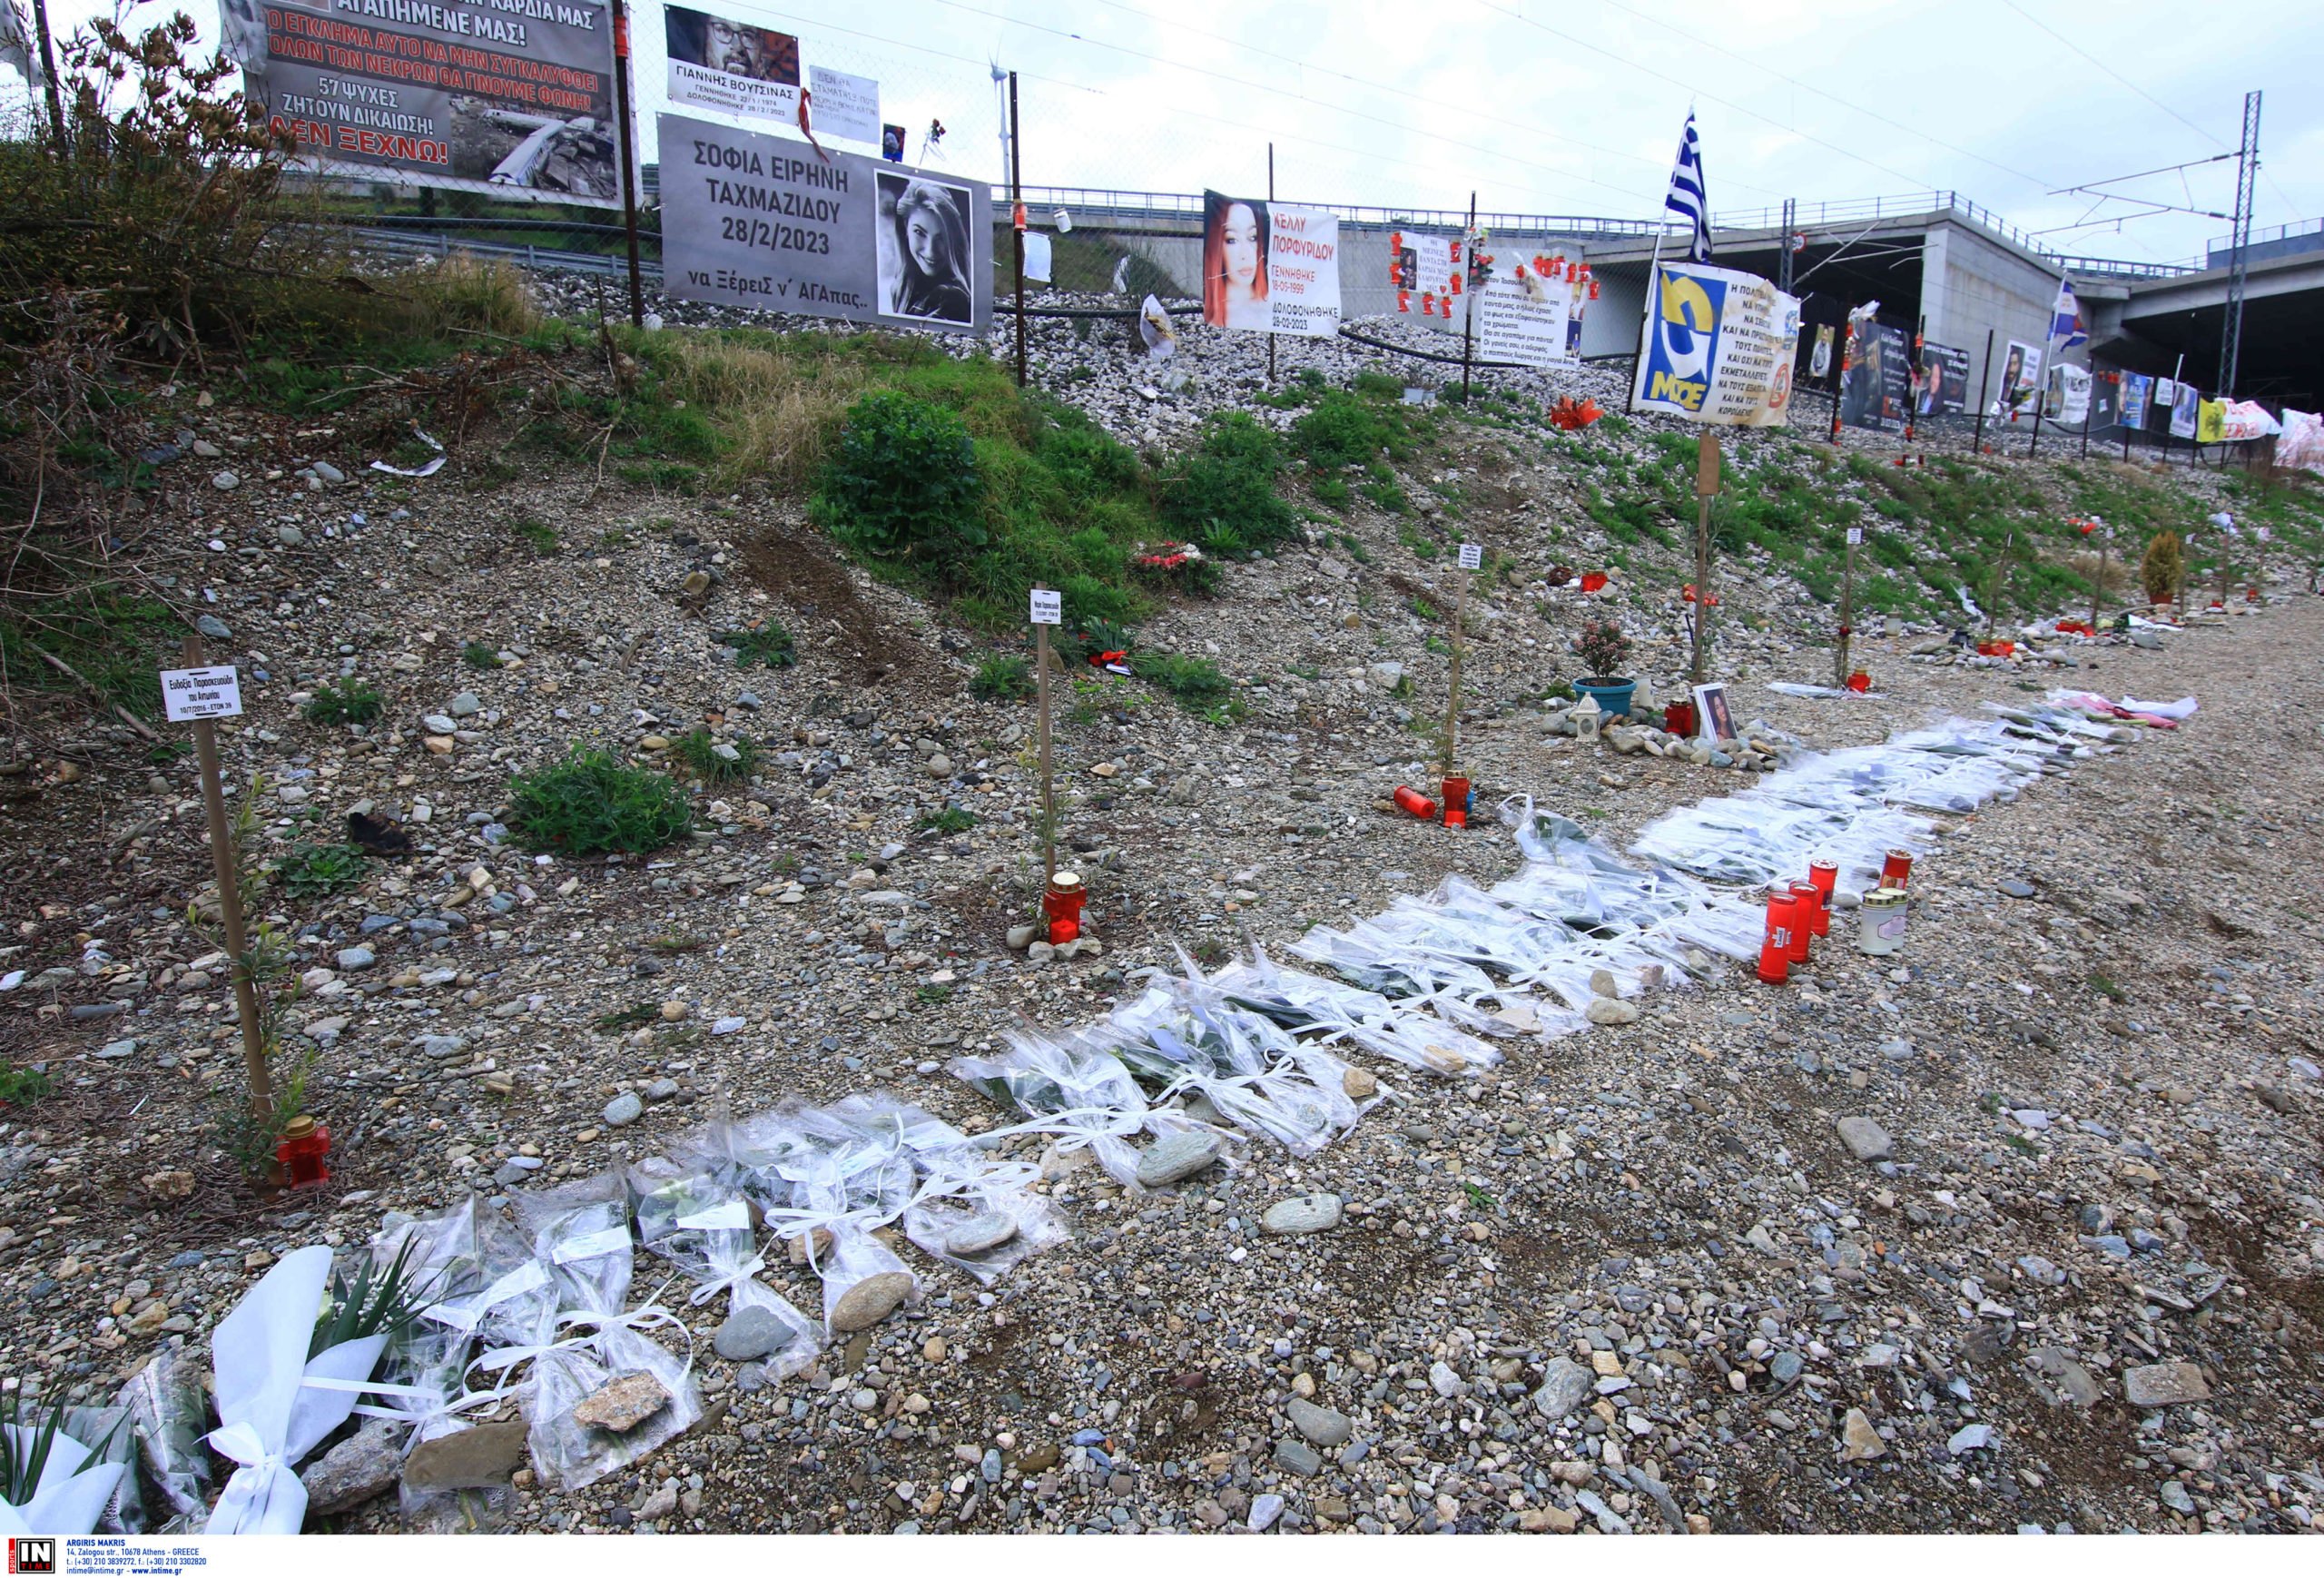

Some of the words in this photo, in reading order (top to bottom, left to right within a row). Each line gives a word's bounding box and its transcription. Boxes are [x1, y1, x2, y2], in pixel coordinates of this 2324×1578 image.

[557, 5, 594, 30] ΜΑΣ
[475, 15, 527, 46] ΜΑΣ!
[285, 13, 372, 49] ΕΓΚΛΗΜΑ
[374, 31, 419, 56] ΑΥΤΟ
[423, 44, 448, 63] ΝΑ
[449, 46, 487, 70] ΜΗΝ
[490, 55, 598, 92] ΣΥΓΚΑΛΥΦΘΕΙ
[269, 35, 323, 63] ΟΛΩΝ
[327, 45, 362, 70] ΤΩΝ
[365, 53, 437, 83] ΝΕΚΡΩΝ
[439, 66, 463, 88] ΘΑ
[465, 72, 537, 103] ΓΙΝΟΥΜΕ
[537, 86, 591, 112] ΦΩΝΗ!
[676, 65, 727, 87] ΓΙΑΝΝΗΣ
[730, 79, 794, 100] ΒΟΥΤΣΙΝΑΣ
[319, 77, 338, 96] 57
[341, 81, 399, 108] ΨΥΧΕΣ
[694, 84, 736, 100] ΓΕΝΝΗΘΗΚΕ
[686, 92, 744, 111] ΔΟΛΟΦΟΝΗΘΗΚΕ
[281, 94, 350, 122] ΖΗΤΟΥΝ
[353, 109, 433, 135] ΔΙΚΑΙΩΣΗ!
[337, 125, 448, 164] ΞΕΧΝΩ!
[694, 141, 763, 176] ΣΟΦΙΑ
[772, 154, 849, 192] ΕΙΡΗΝΗ
[705, 178, 841, 224] ΤΑΧΜΑΖΙΔΟΥ
[1273, 212, 1305, 232] ΚΕΛΛΥ
[722, 217, 831, 255] 28/2/2023
[1273, 234, 1334, 261] ΠΟΡΦΥΡΙΔΟΥ
[687, 271, 711, 287] να
[1271, 264, 1315, 282] ΓΕΝΝΗΘΗΚΕ
[1731, 284, 1738, 292] Η
[1273, 302, 1338, 319] ΔΟΛΟΦΟΝΗΘΗΚΕ
[1743, 301, 1752, 310] ΝΑ
[1273, 316, 1308, 330] 28-02-2023
[1744, 315, 1753, 324] ΝΑ
[1722, 325, 1738, 335] ΚΑΙ
[1739, 328, 1749, 338] ΝΑ
[1735, 340, 1752, 351] ΤΟΥΣ
[1728, 353, 1740, 363] ΚΑΙ
[1741, 356, 1752, 364] ΟΧΙ
[1718, 380, 1728, 389] ΝΑ
[1729, 381, 1746, 390] ΤΟΥΣ
[1722, 394, 1735, 402] ΚΑΙ
[169, 678, 192, 690] Ευδοξία
[188, 694, 197, 702] του
[210, 703, 224, 711] ΕΤΩΝ
